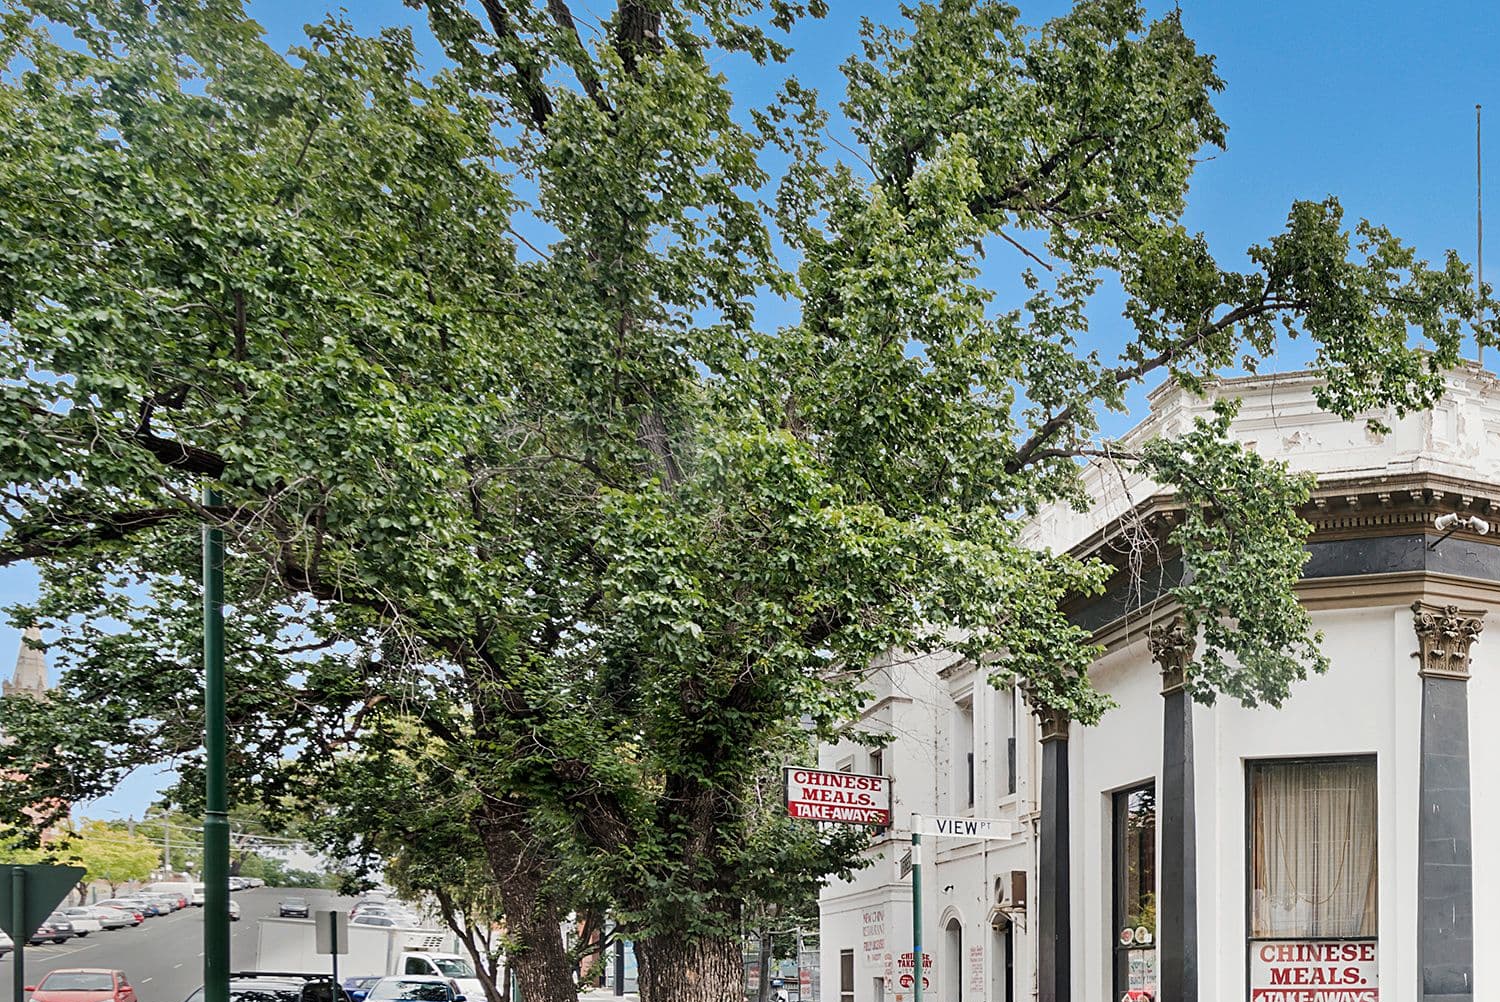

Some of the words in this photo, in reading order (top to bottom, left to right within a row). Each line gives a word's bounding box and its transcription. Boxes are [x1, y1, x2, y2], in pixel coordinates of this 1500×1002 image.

[793, 771, 882, 791] CHINESE
[802, 788, 876, 806] MEALS.
[936, 819, 978, 835] VIEW
[980, 822, 991, 830] PT
[1259, 943, 1375, 962] CHINESE
[1269, 967, 1368, 985] MEALS.
